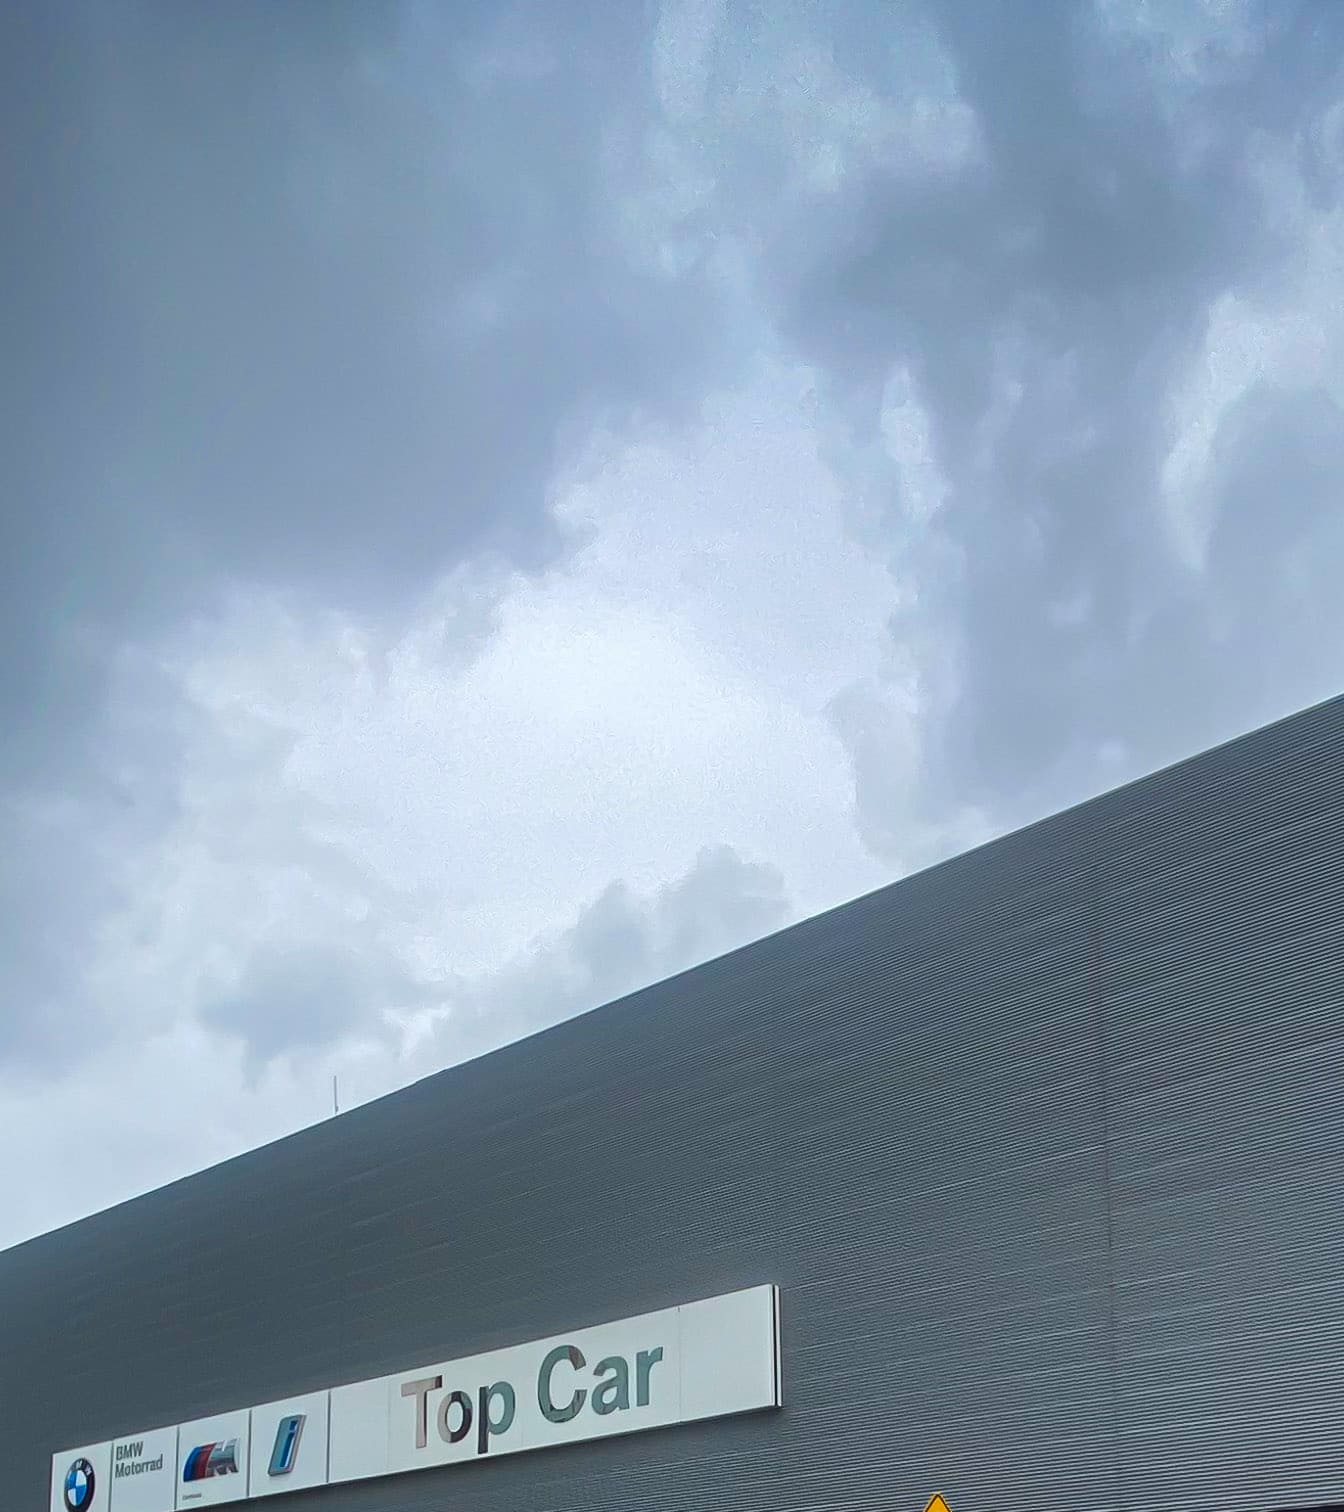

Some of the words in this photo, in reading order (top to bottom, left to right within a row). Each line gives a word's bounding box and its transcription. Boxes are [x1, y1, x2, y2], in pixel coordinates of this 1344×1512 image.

[400, 1374, 516, 1455] Top
[537, 1344, 664, 1424] Car
[116, 1441, 144, 1460] BMW
[115, 1454, 164, 1478] Motorrad
